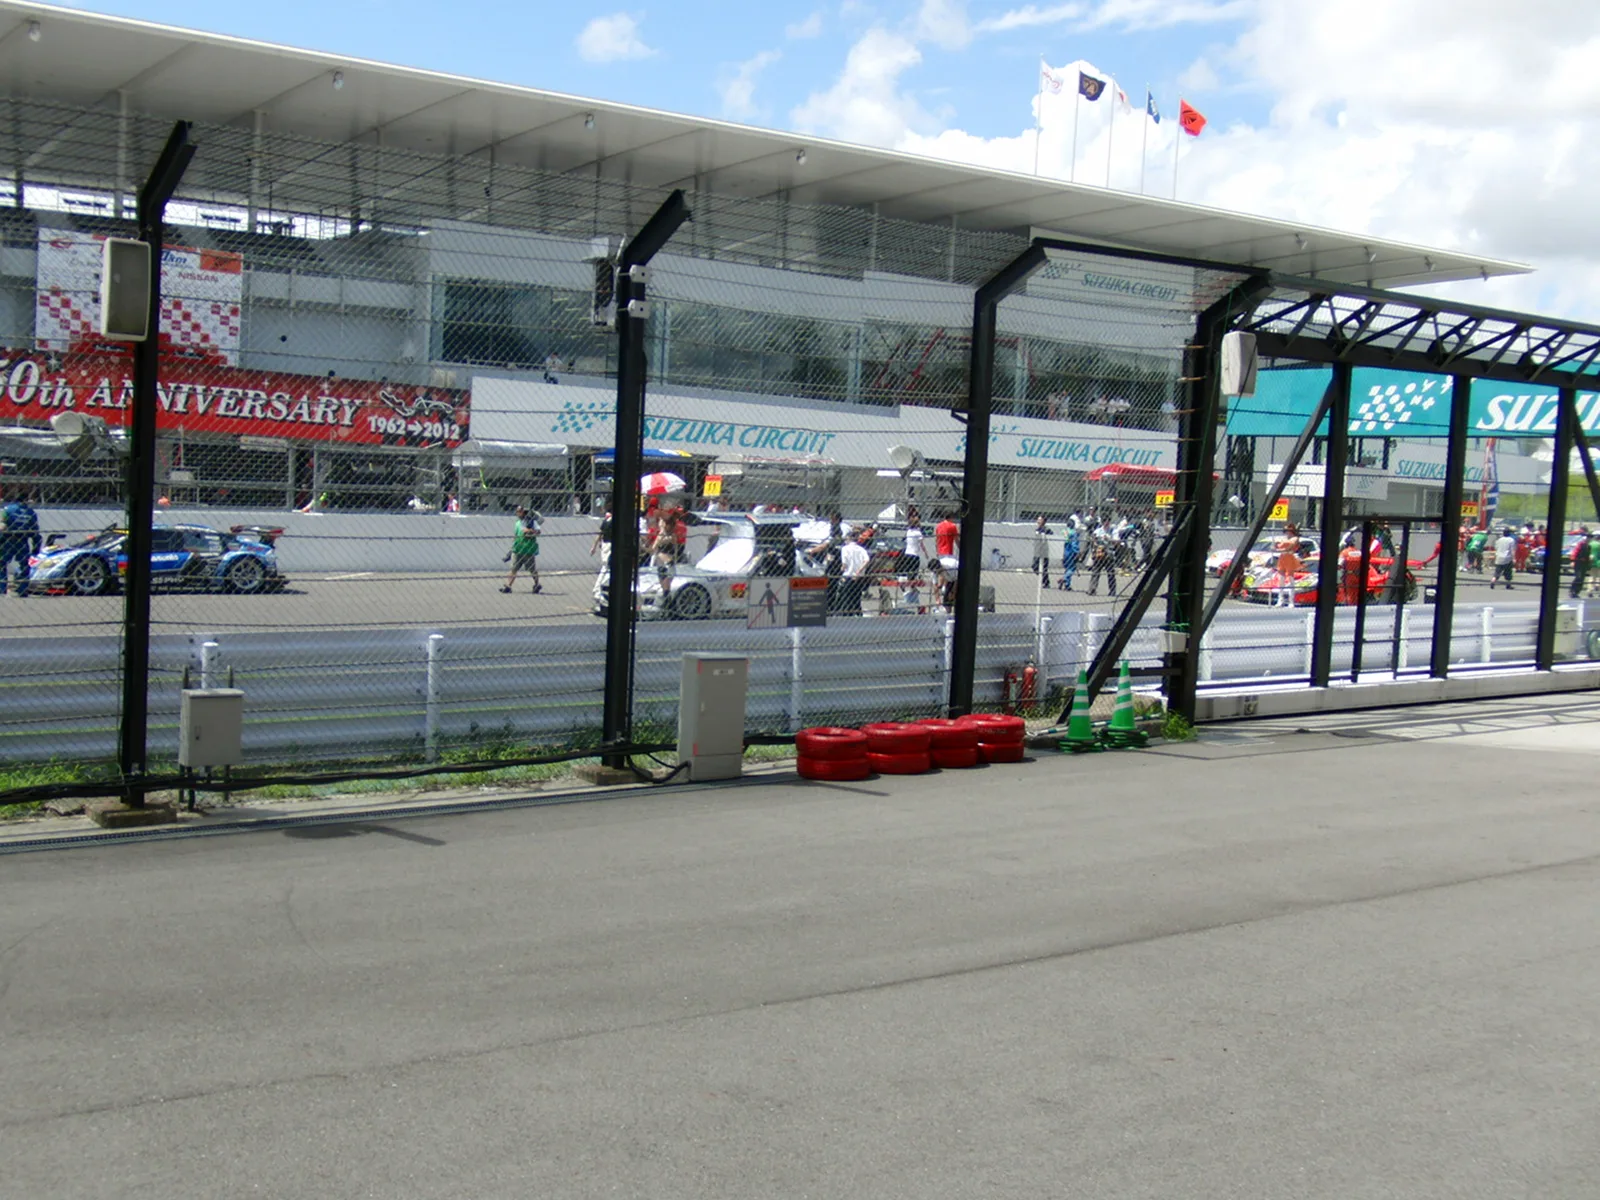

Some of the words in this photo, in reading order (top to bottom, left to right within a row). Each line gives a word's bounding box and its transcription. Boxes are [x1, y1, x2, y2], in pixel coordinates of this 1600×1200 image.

[1081, 273, 1130, 292] SUZUKA
[1130, 281, 1180, 301] CIRCUIT
[1476, 394, 1600, 431] SUZU
[642, 417, 736, 446] SUZUKA
[738, 425, 837, 455] CIRCUIT
[1016, 438, 1091, 462] SUZUKA
[1092, 445, 1163, 467] CIRCUIT
[1395, 460, 1446, 478] SUZUKA
